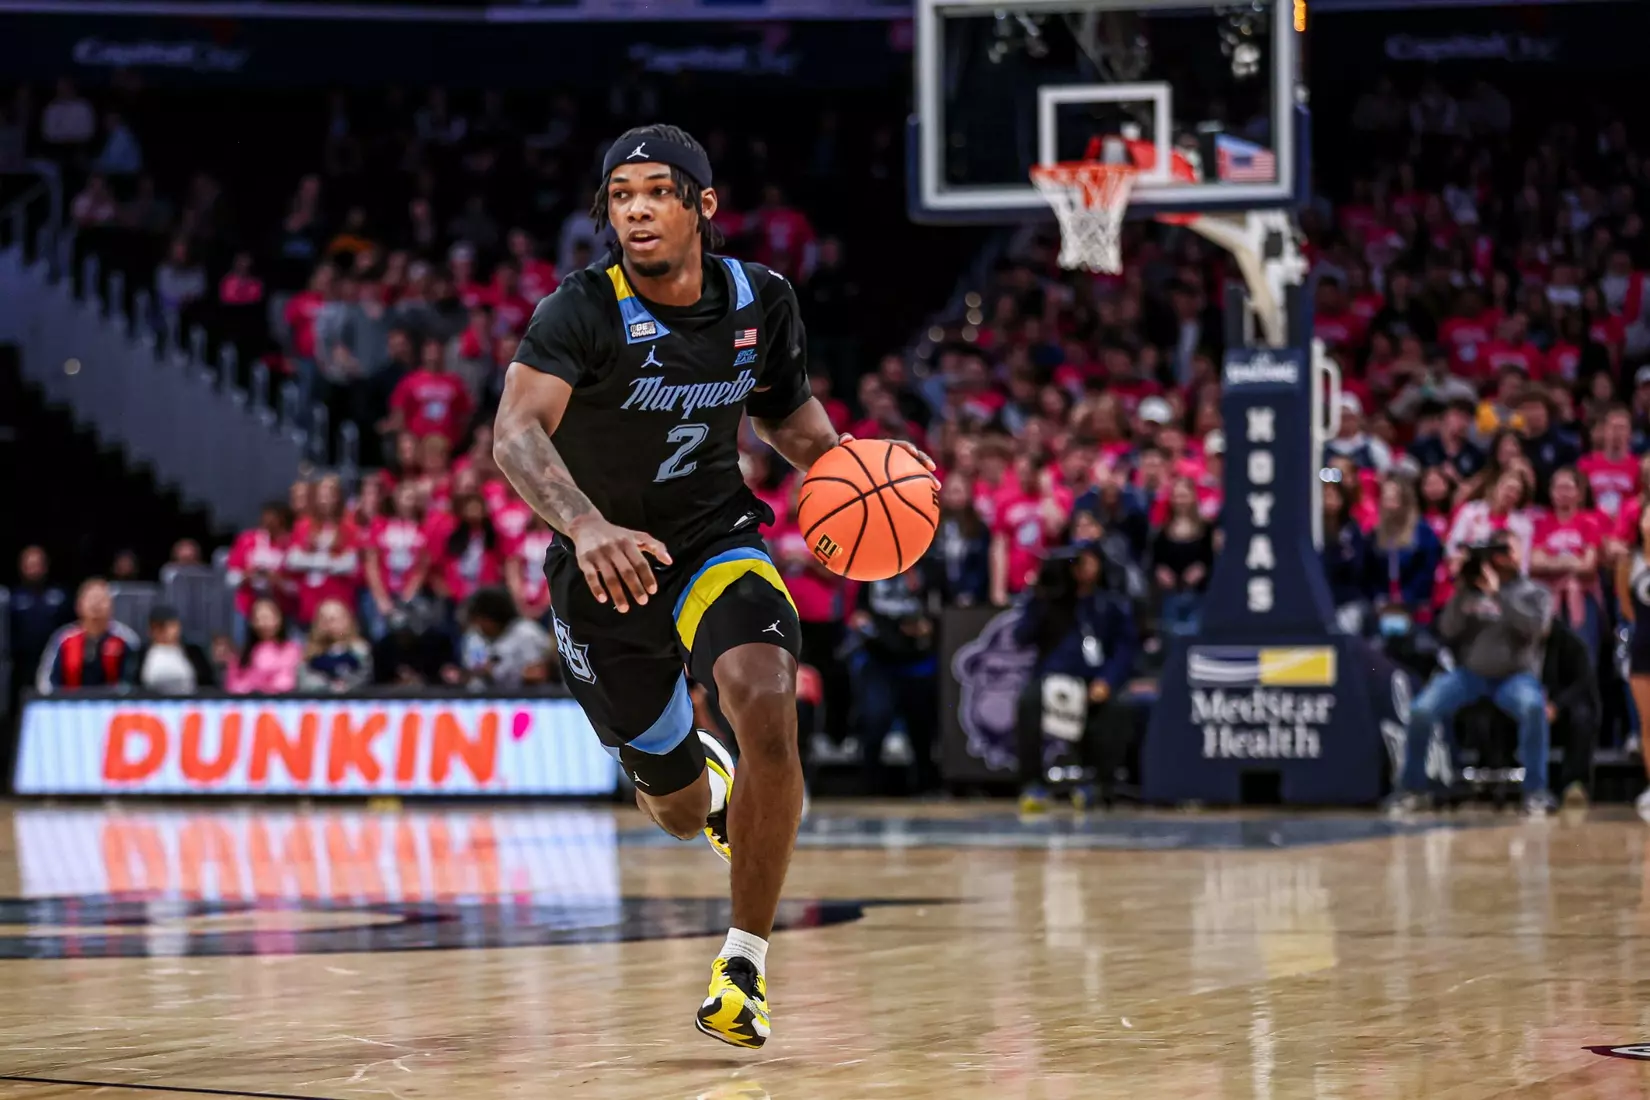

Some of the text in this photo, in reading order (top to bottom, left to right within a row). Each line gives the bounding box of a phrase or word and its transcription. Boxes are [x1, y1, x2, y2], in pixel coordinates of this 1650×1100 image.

[620, 369, 757, 420] Marquette
[652, 423, 710, 483] 2
[1191, 686, 1336, 724] MedStar
[102, 710, 532, 785] DUNKIN'
[1203, 722, 1321, 759] Health
